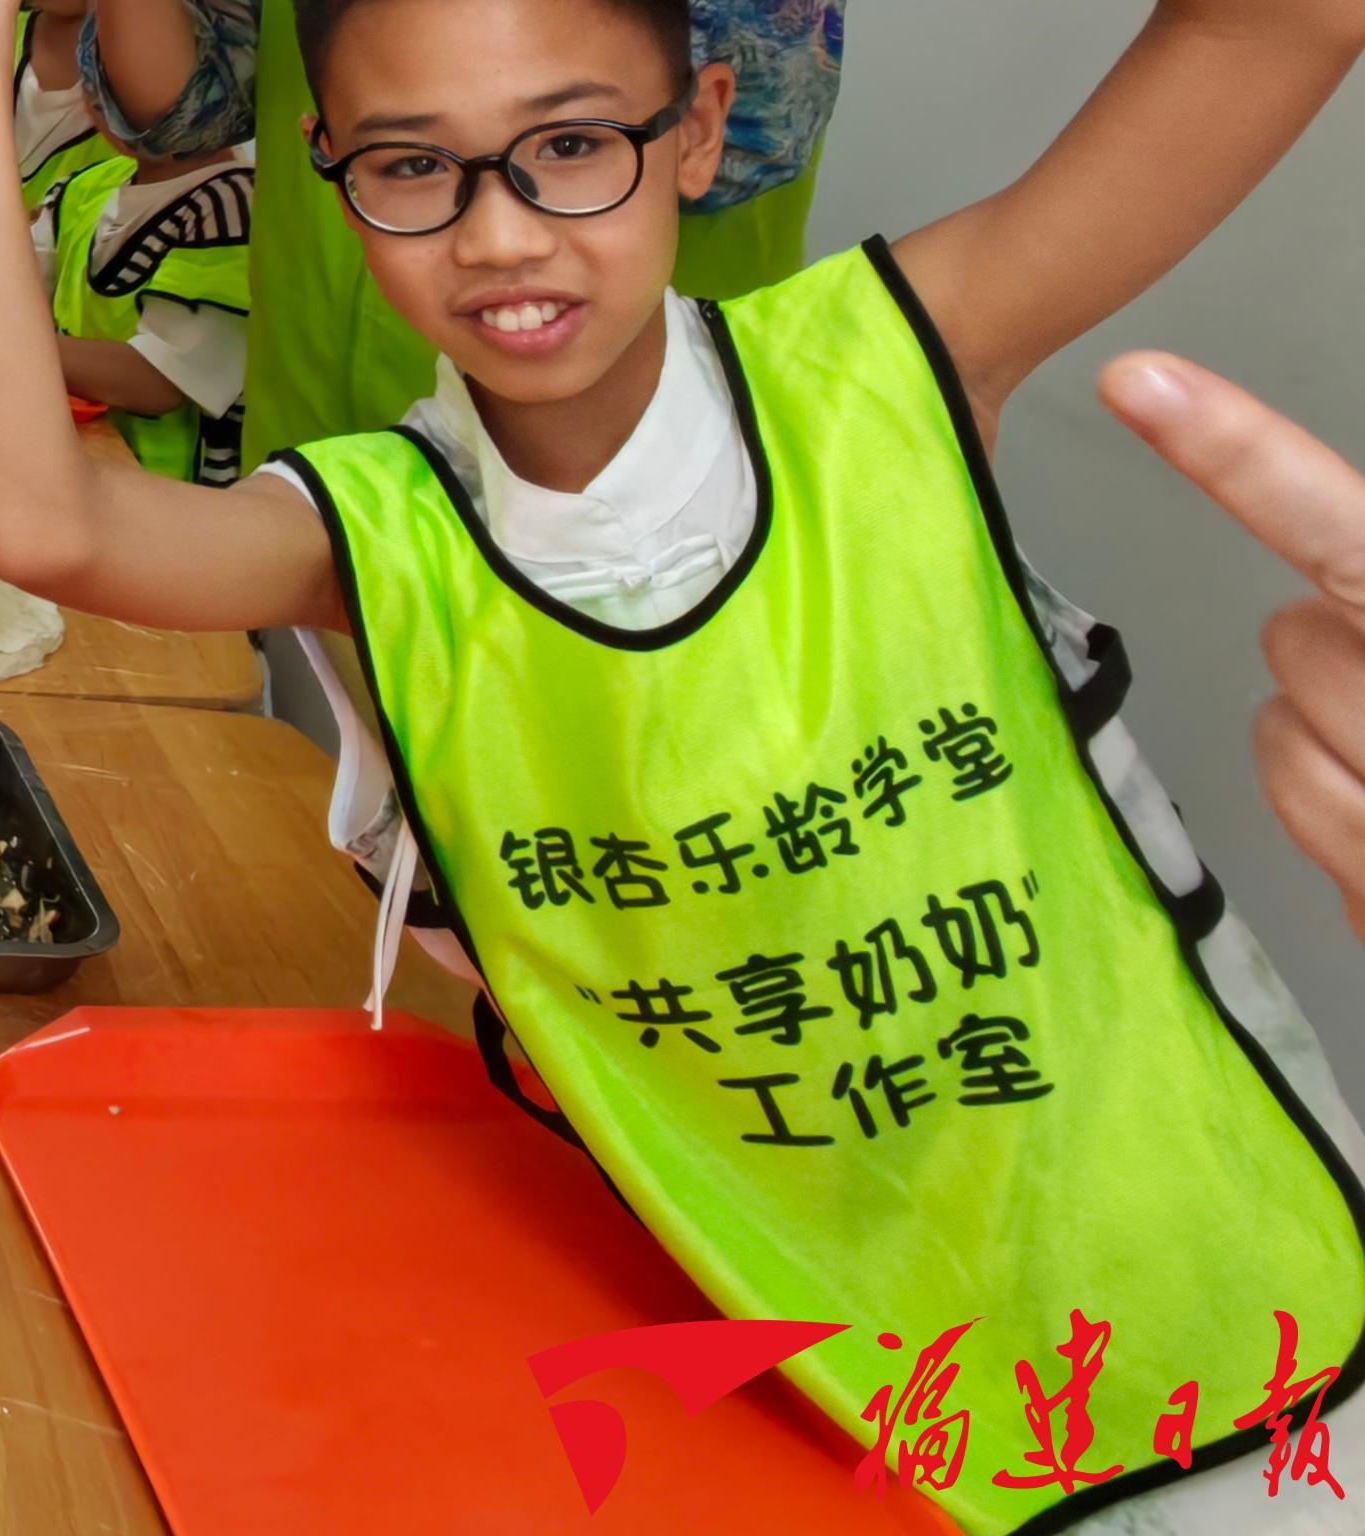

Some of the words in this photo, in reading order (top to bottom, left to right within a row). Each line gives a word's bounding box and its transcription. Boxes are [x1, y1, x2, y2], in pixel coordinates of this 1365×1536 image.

[499, 702, 1014, 910] 银杏乐龄学堂
[717, 1014, 1055, 1147] 工作室
